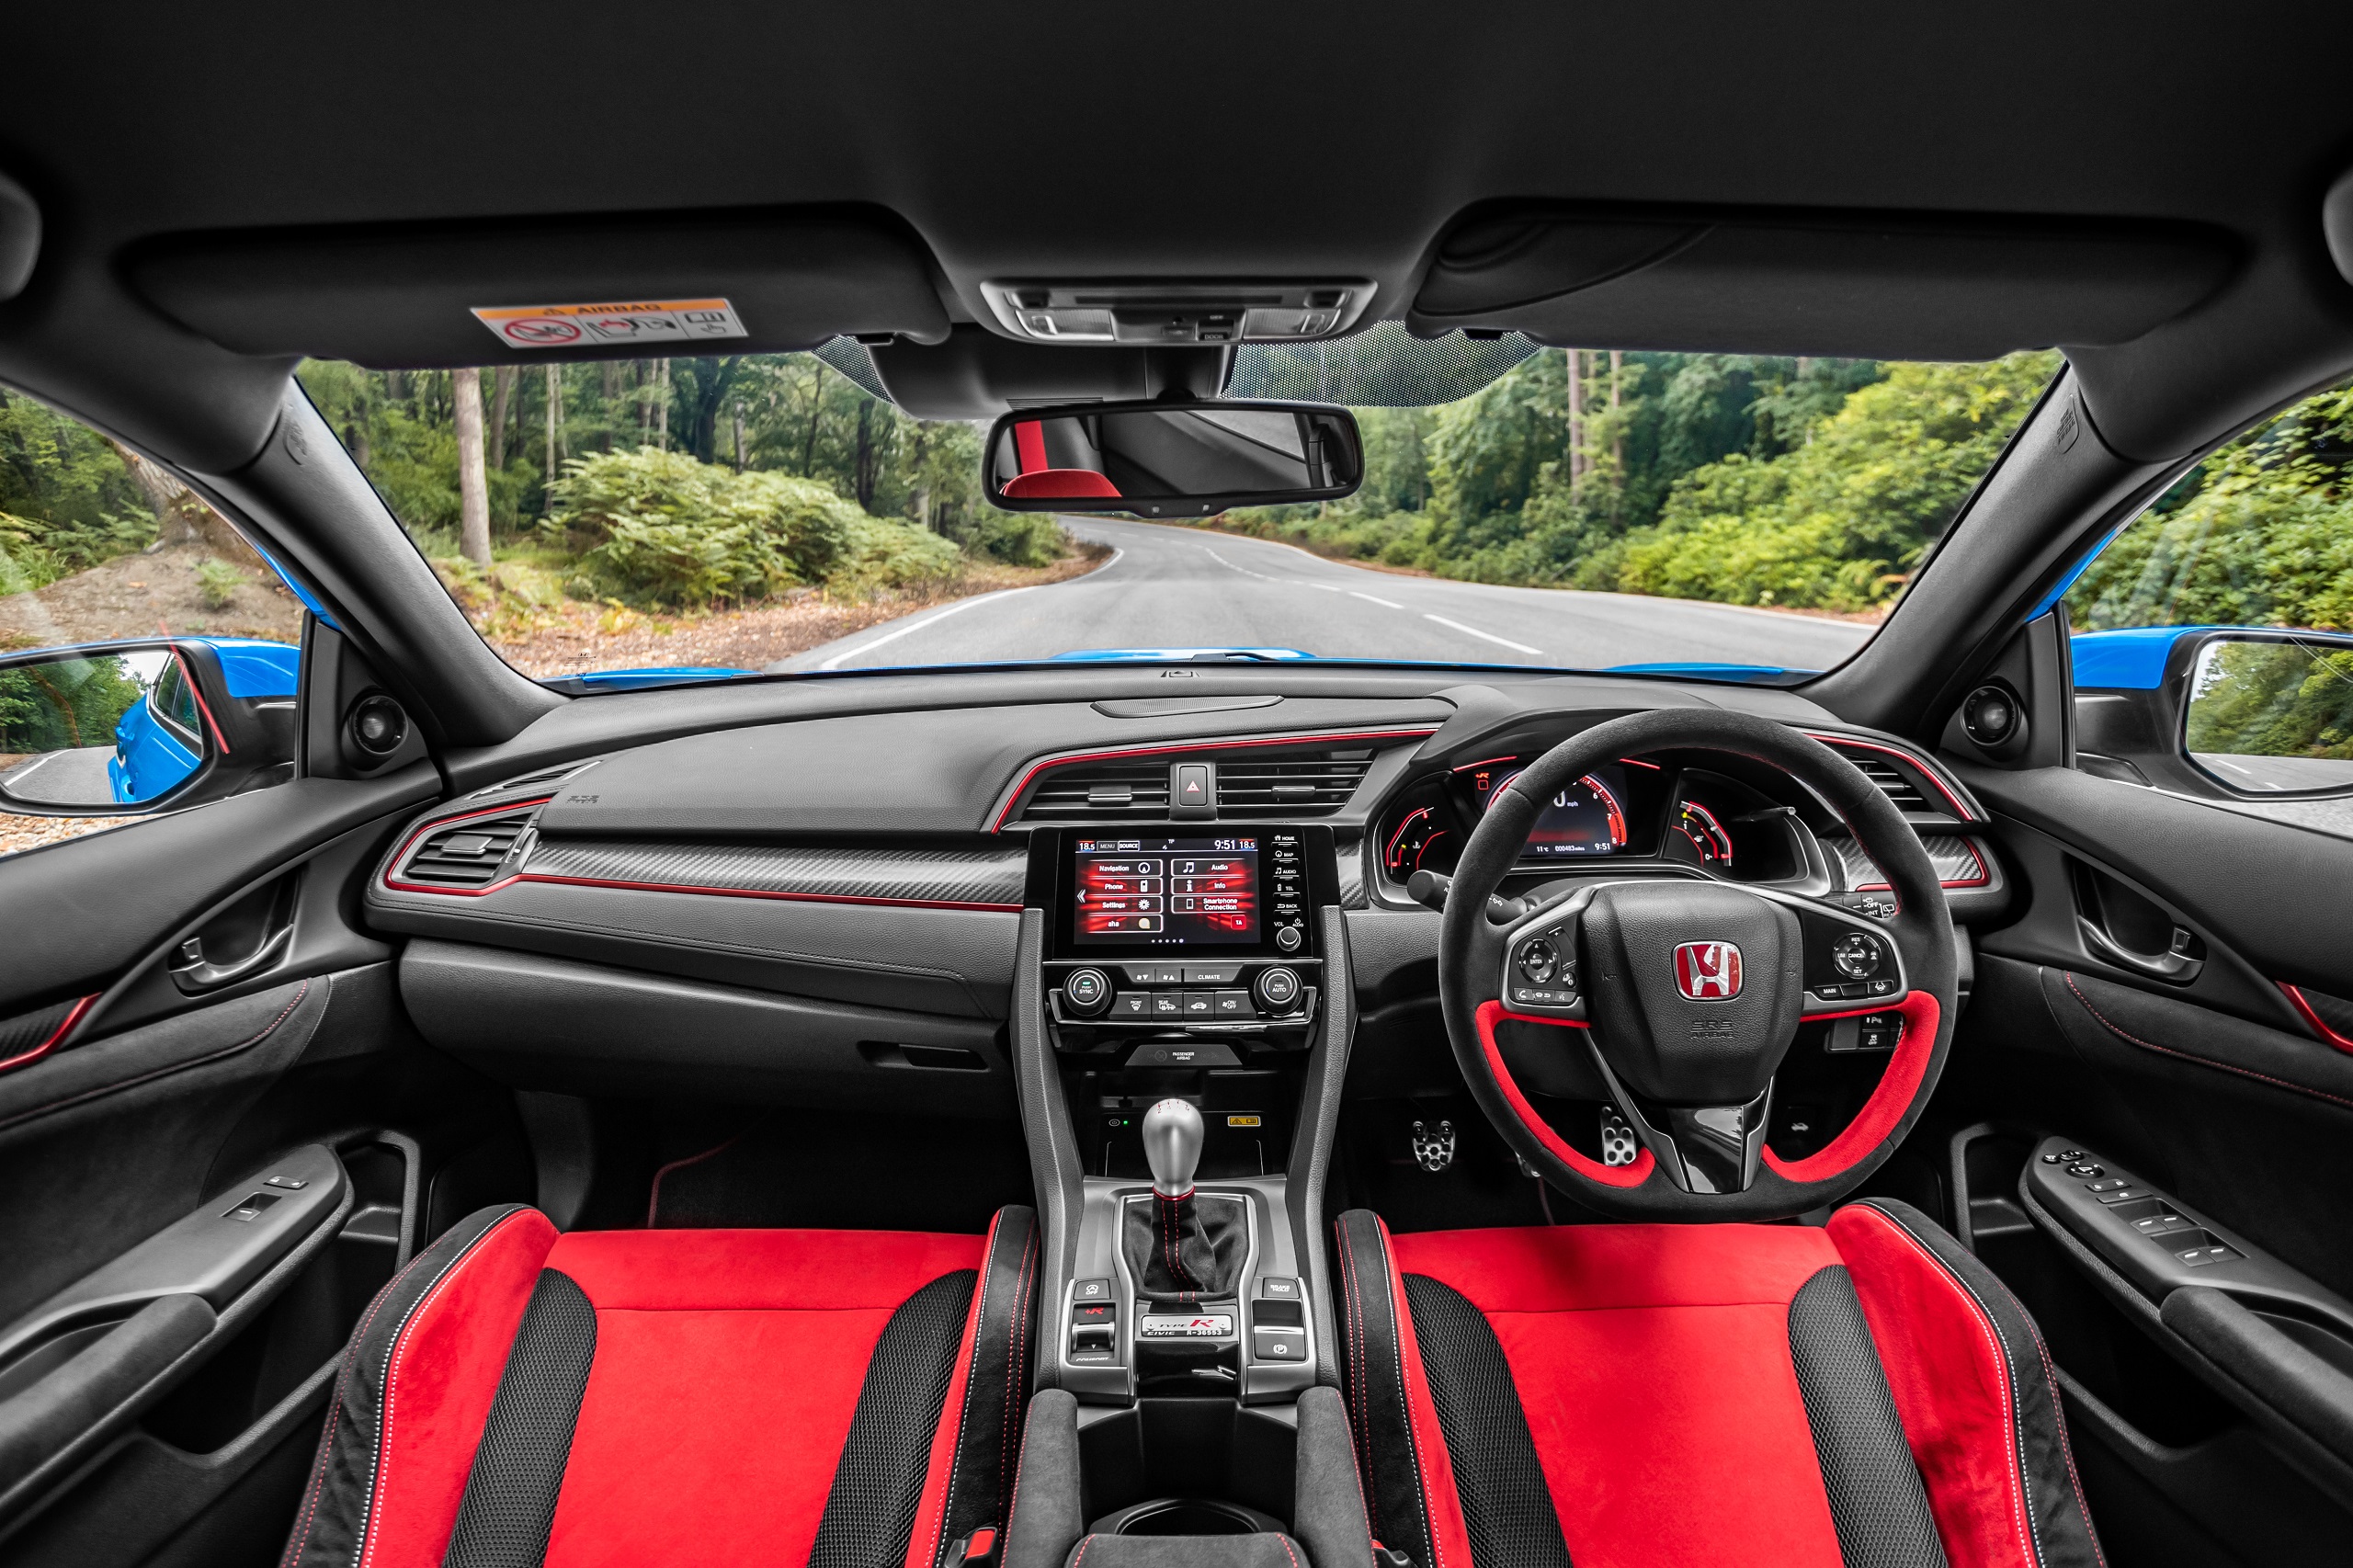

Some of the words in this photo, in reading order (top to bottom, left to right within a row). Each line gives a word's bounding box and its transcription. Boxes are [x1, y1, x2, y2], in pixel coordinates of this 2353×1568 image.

[577, 303, 662, 314] AIRBAG
[1214, 840, 1235, 849] 9:51
[1239, 841, 1256, 849] 18.5
[1189, 1319, 1214, 1327] R
